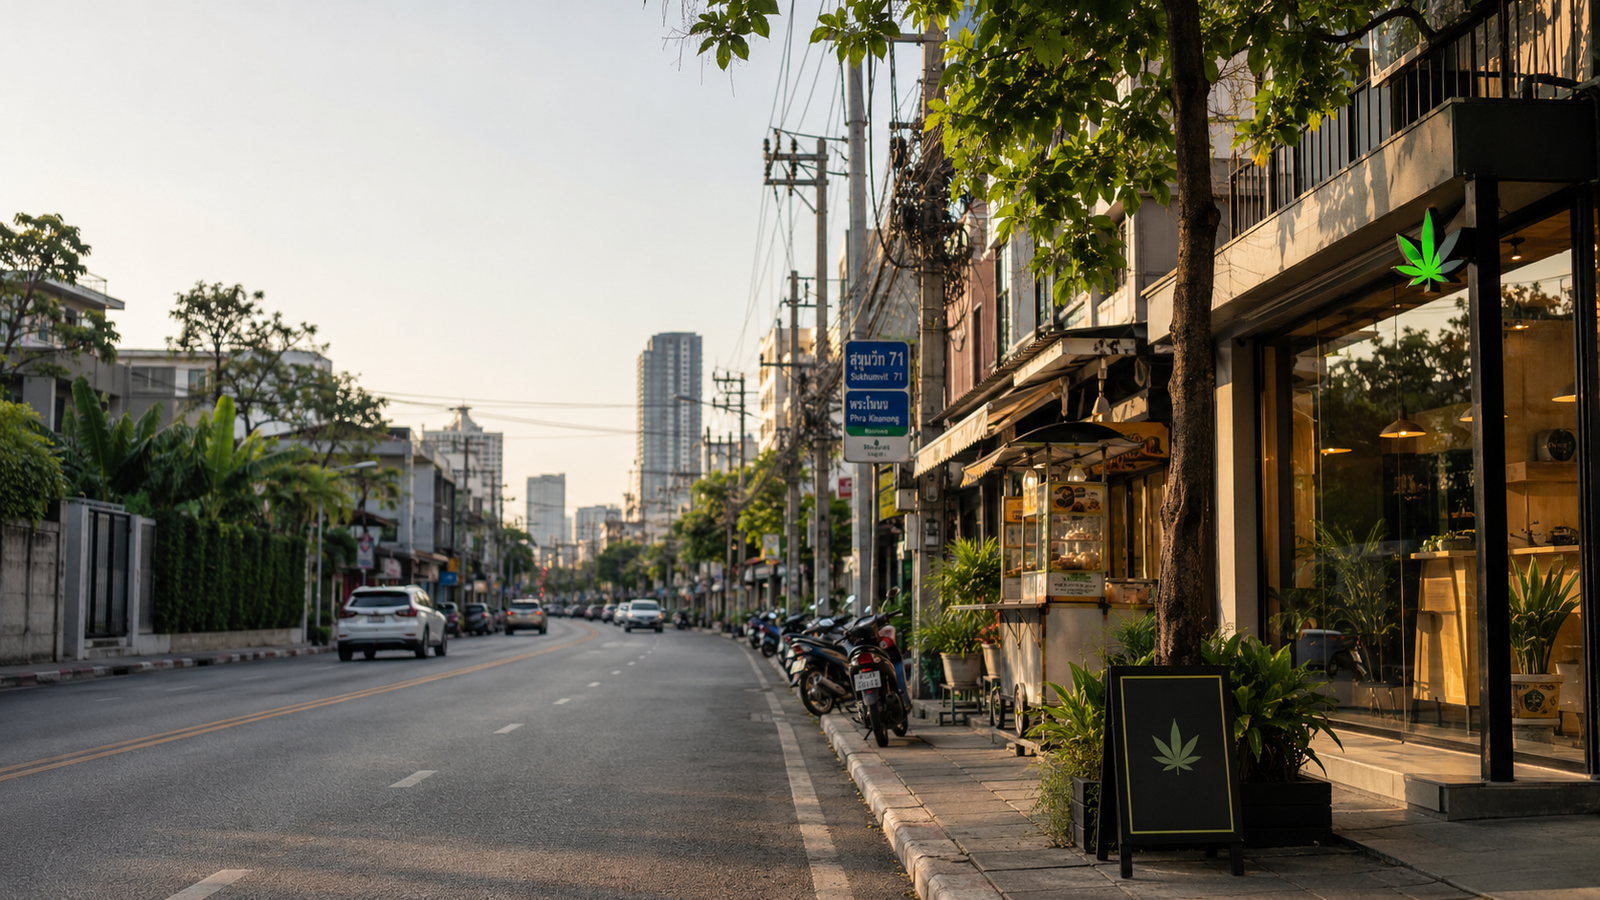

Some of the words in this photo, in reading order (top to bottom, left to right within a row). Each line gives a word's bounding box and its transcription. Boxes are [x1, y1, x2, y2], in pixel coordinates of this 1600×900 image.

[889, 351, 903, 366] 71
[893, 372, 903, 381] 71
[850, 413, 867, 422] Phra
